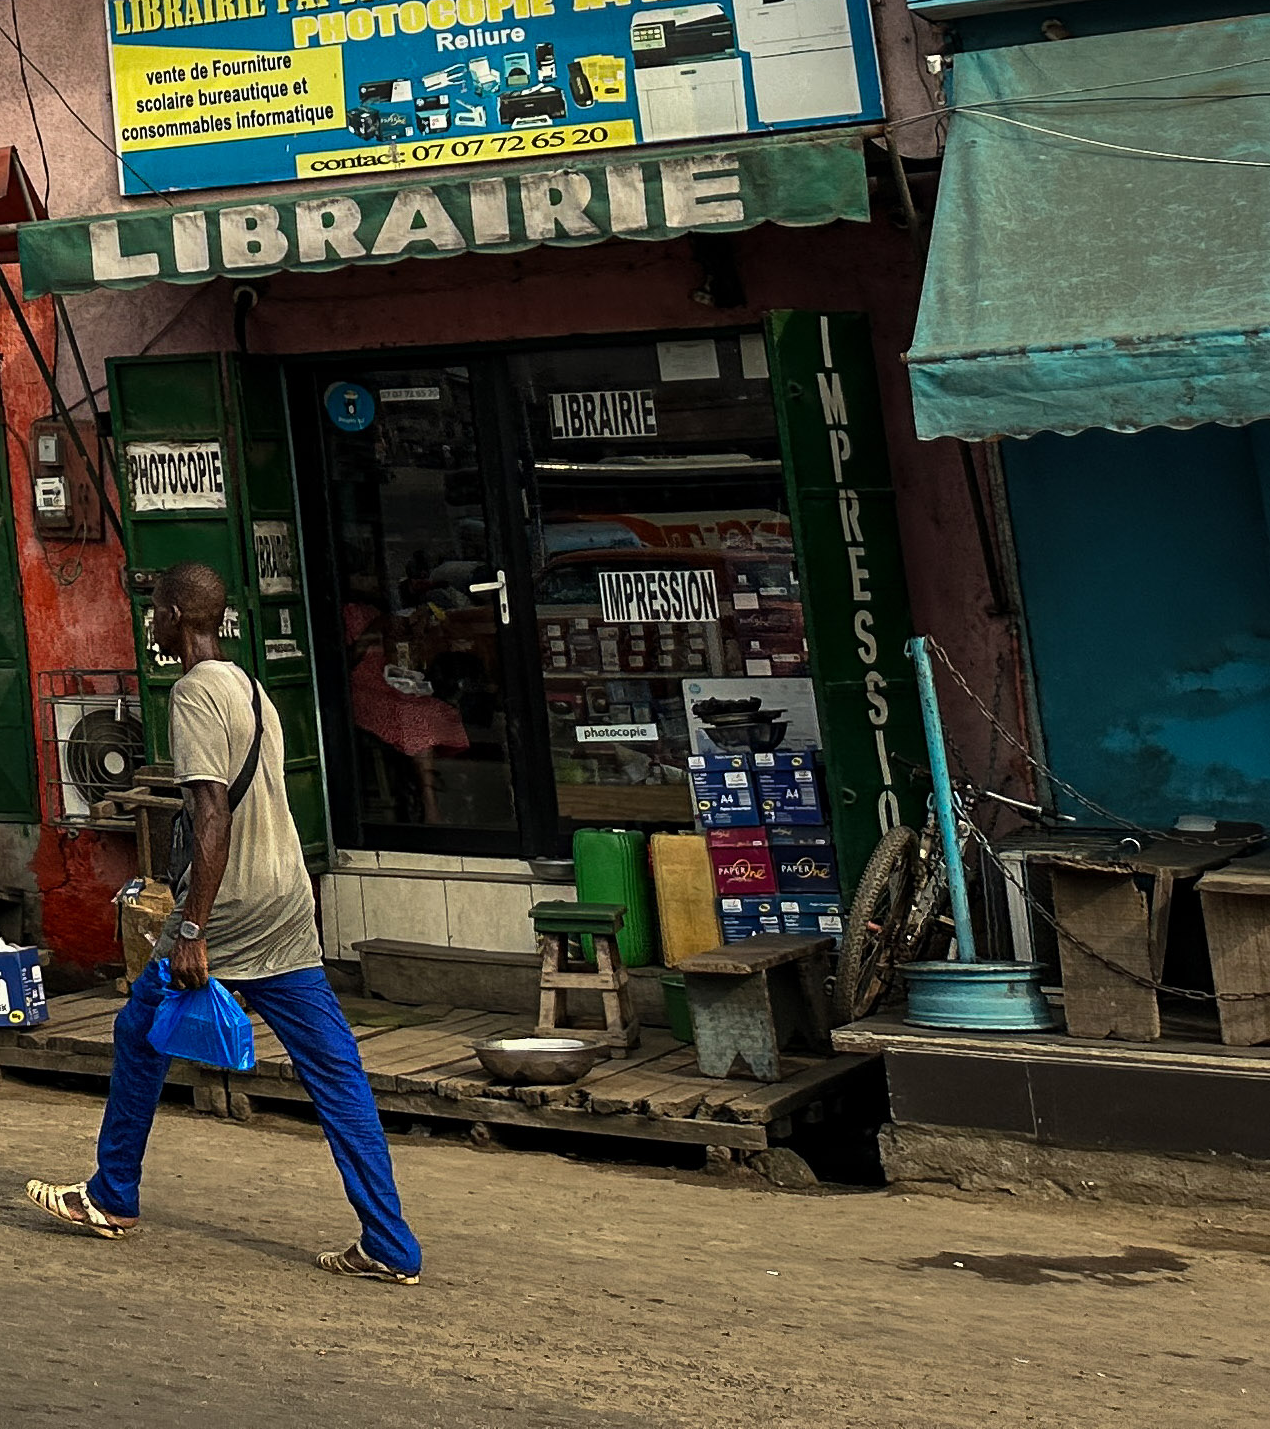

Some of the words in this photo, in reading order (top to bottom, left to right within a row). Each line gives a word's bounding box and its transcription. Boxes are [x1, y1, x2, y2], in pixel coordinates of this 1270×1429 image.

[436, 26, 526, 52] Reliure
[146, 67, 187, 85] vente
[190, 62, 208, 80] de
[212, 54, 292, 78] Fourniture
[136, 93, 194, 113] scolaire
[198, 82, 288, 108] bureautique
[293, 78, 308, 96] et
[122, 114, 231, 141] consommables
[235, 103, 334, 130] informatique
[412, 142, 444, 162] 07
[450, 139, 484, 159] 07
[490, 135, 526, 153] 72
[531, 131, 565, 149] 65
[573, 127, 608, 144] 20
[89, 153, 745, 280] LIBRAIRIE
[551, 391, 656, 437] LIBRAIRIE
[128, 451, 223, 494] PHOTOCOPIE
[817, 315, 901, 836] IMPRESSIO
[600, 570, 718, 621] IMPRESSION
[584, 727, 647, 739] photocopie
[720, 794, 733, 804] A4
[785, 788, 799, 799] A4
[718, 866, 746, 876] PAPER
[781, 864, 809, 873] PAPER
